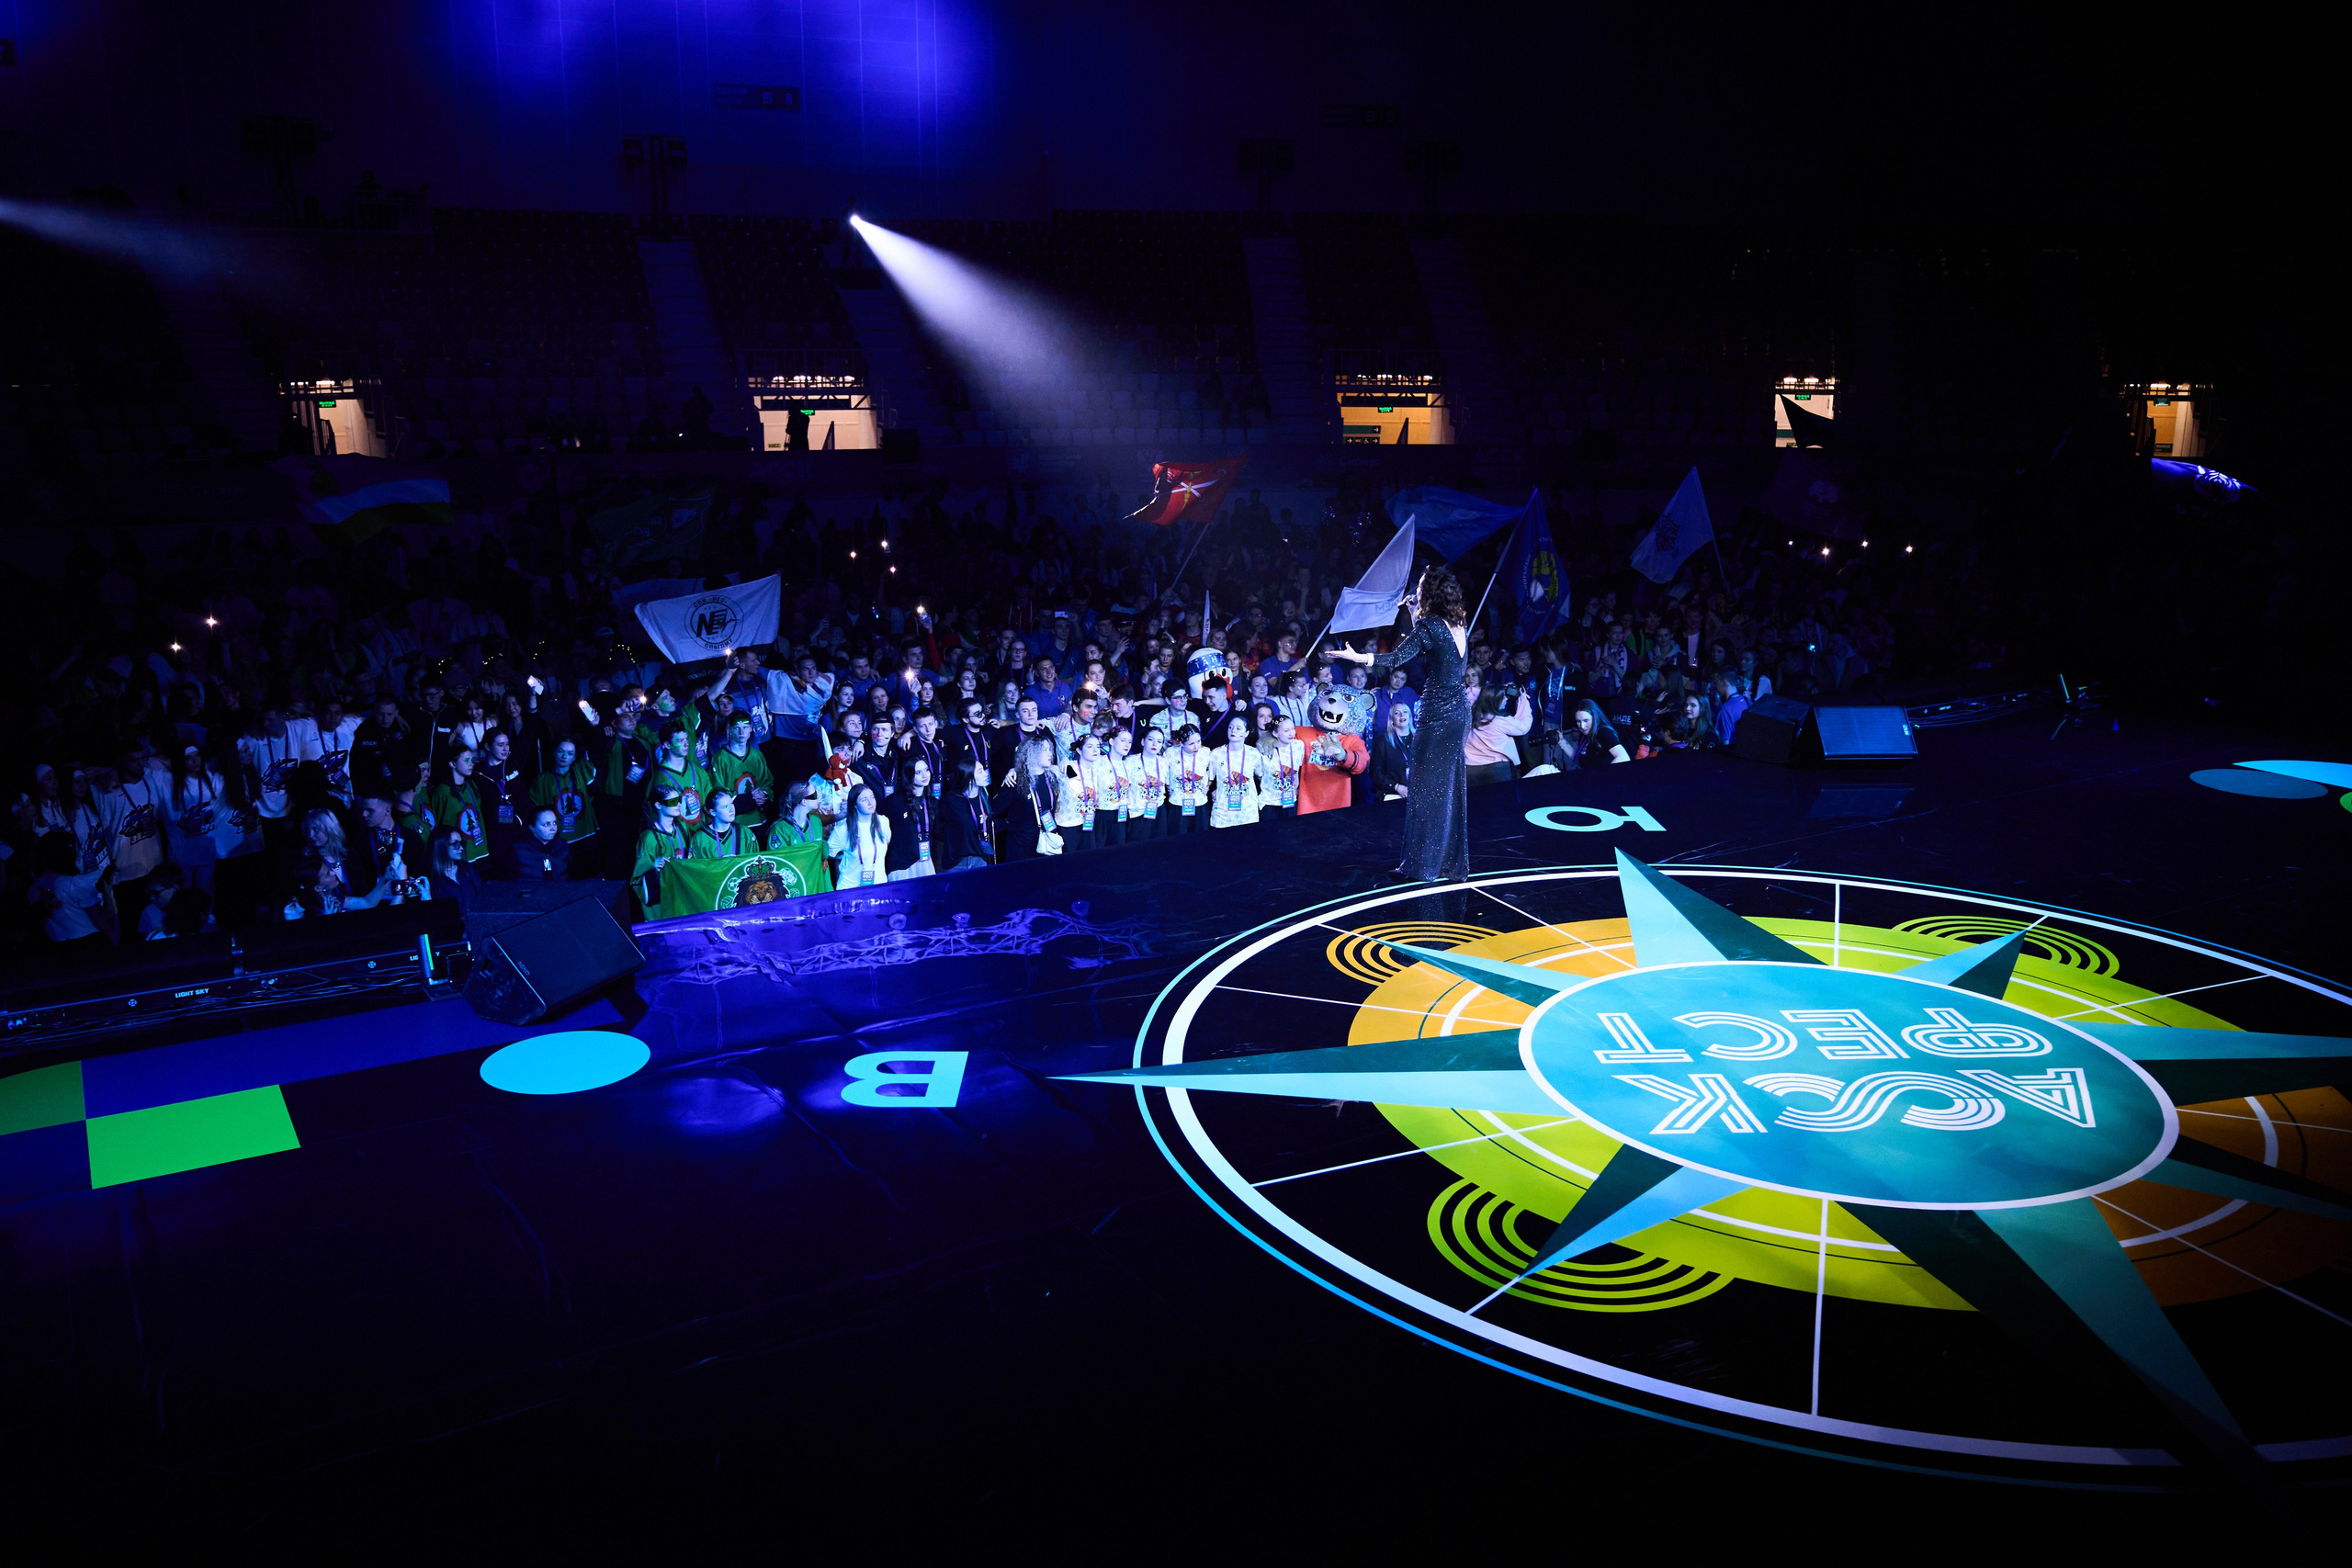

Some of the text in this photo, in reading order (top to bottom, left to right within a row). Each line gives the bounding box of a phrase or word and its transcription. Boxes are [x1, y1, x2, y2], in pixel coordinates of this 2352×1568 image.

[175, 987, 209, 998] LIGHT SKY
[1611, 1067, 2097, 1134] АССК
